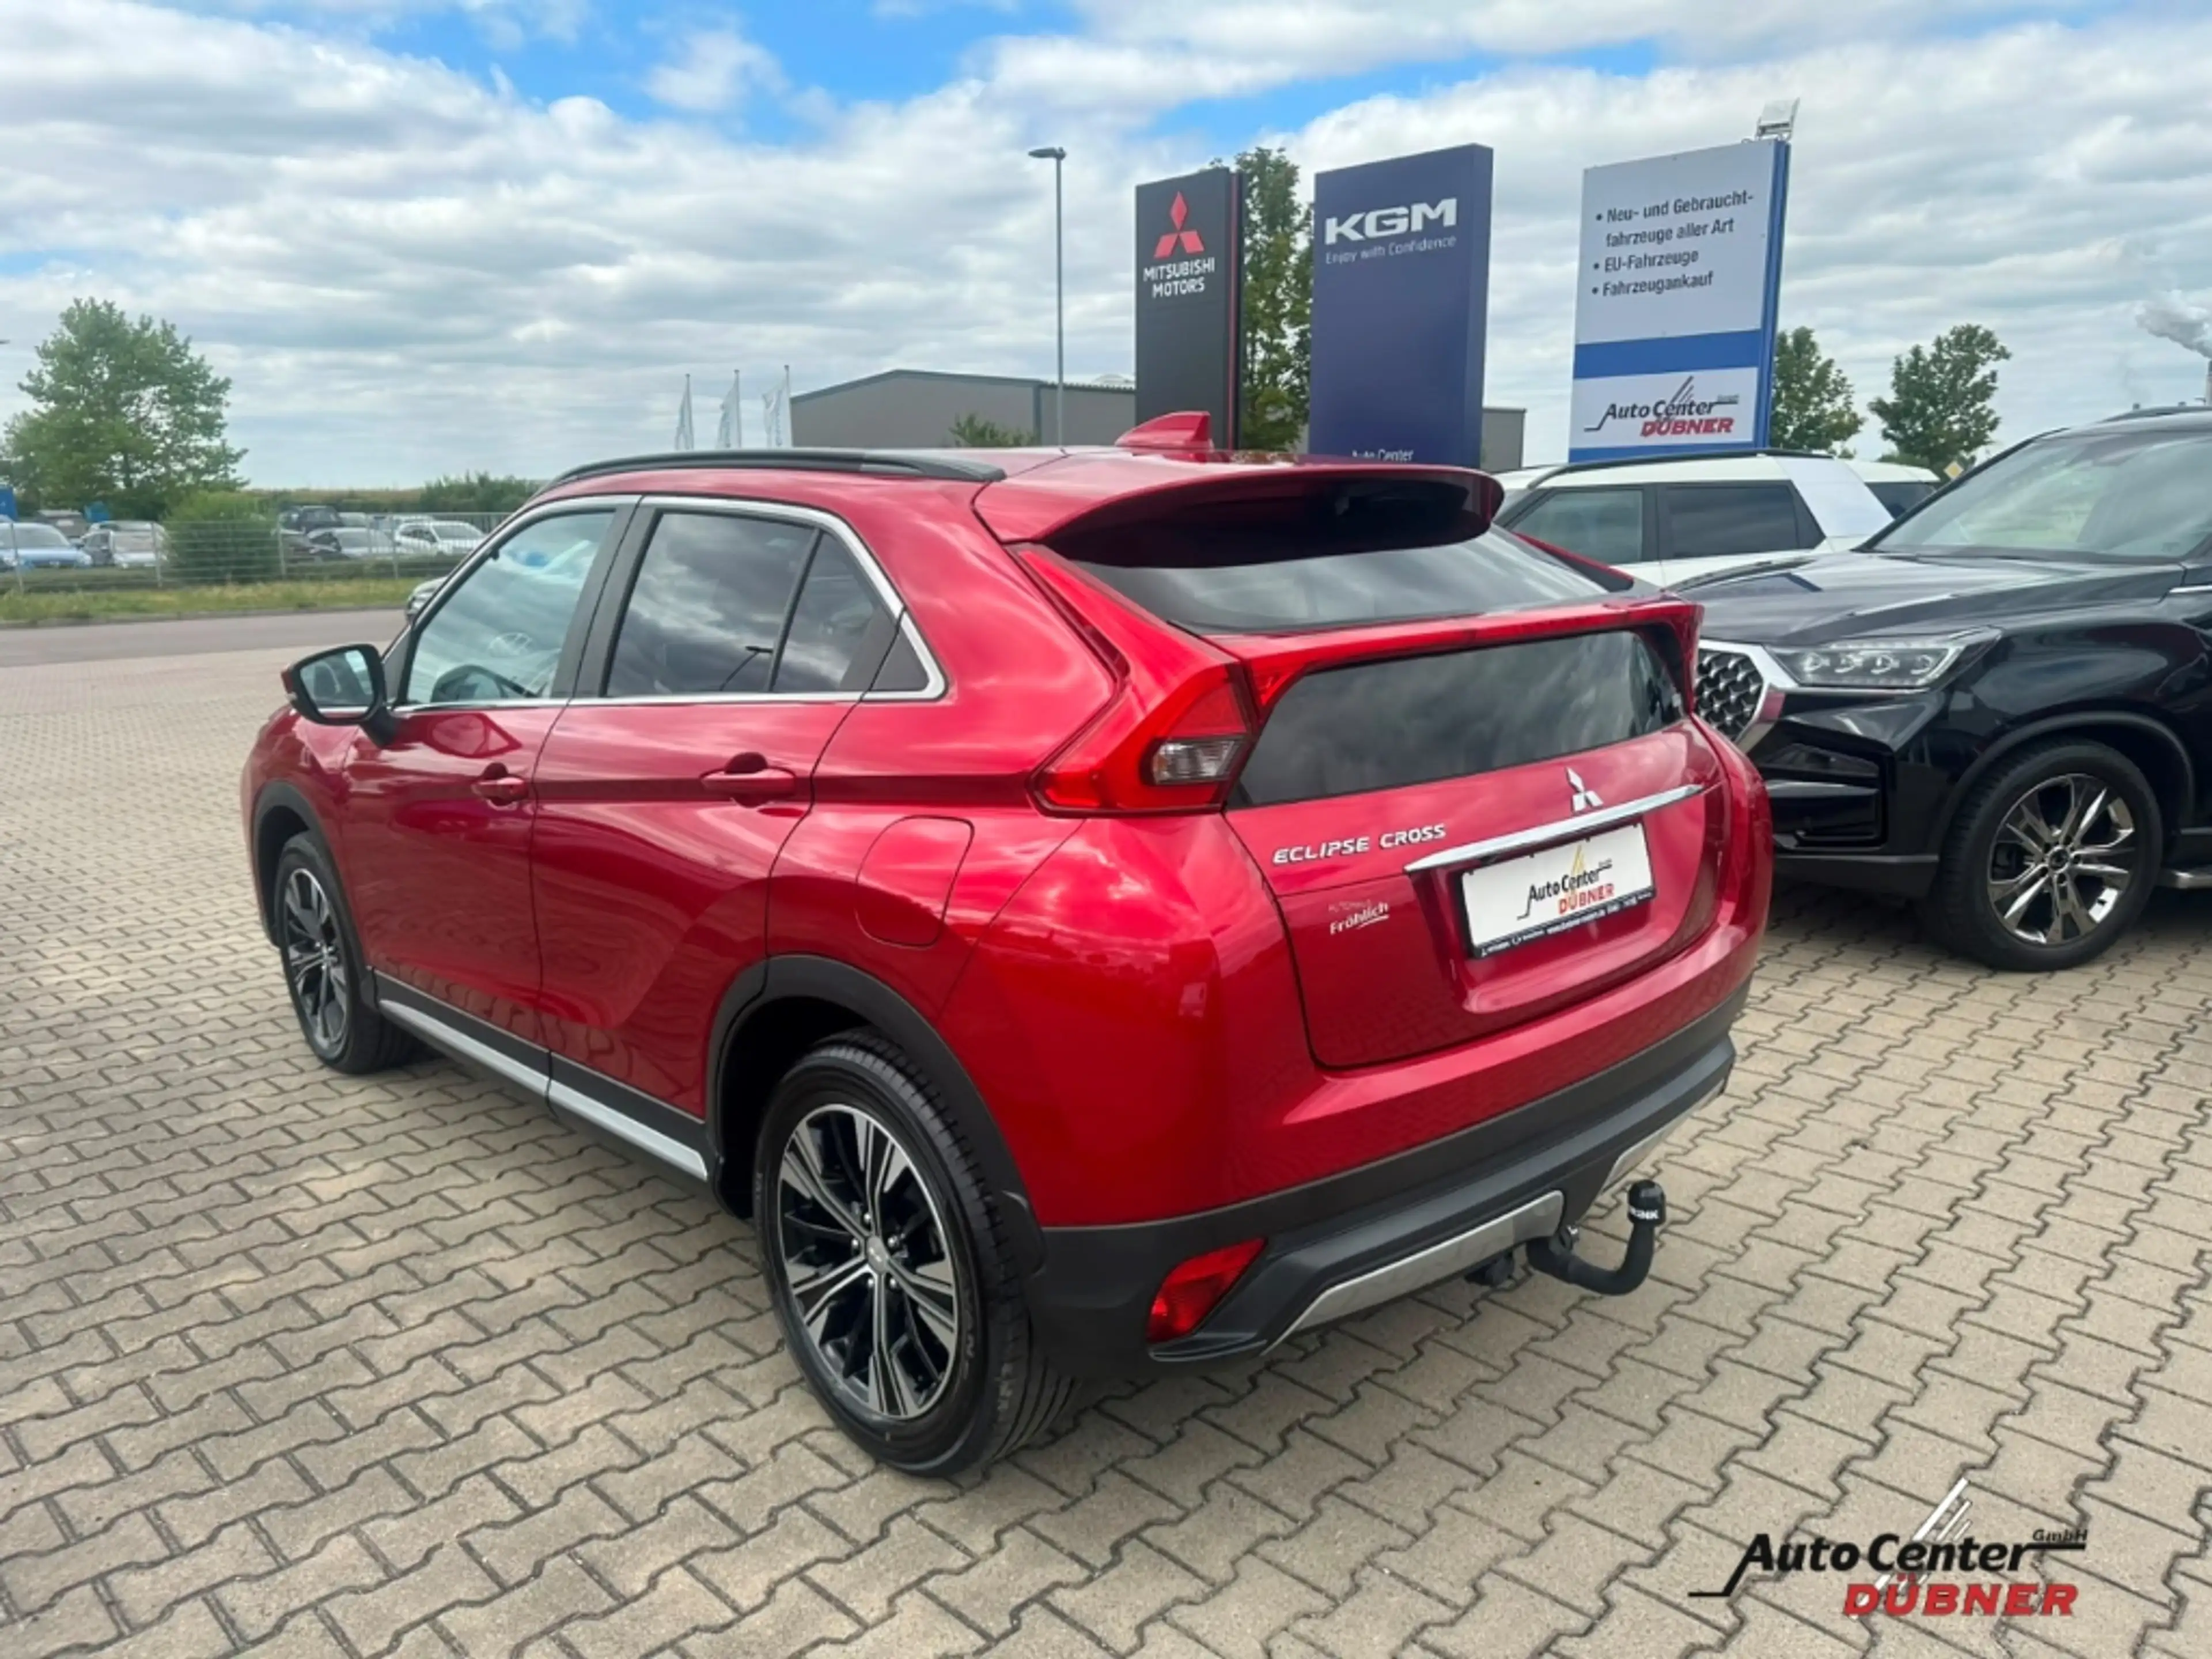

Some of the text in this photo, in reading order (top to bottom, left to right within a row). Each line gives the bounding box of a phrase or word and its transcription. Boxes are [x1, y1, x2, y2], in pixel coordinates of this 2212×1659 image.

[1607, 190, 1754, 223] Neu- und Gebraucht-
[1325, 198, 1457, 245] KGM
[1606, 218, 1734, 247] fahrzeuge aller Art
[1325, 235, 1457, 265] Enjoy with Confidence
[1604, 249, 1699, 273] EU-Fahrzeuge
[1143, 257, 1215, 282] MITSUBISHI
[1152, 276, 1205, 298] MOTORS
[1602, 270, 1714, 297] Fahrzeugankauf
[1605, 400, 1715, 419] Auto Center
[1640, 416, 1734, 437] DÜBNER
[1272, 823, 1446, 863] ECLIPSE CROSS
[1562, 869, 1600, 893] Center
[1330, 902, 1389, 934] Fröhlich
